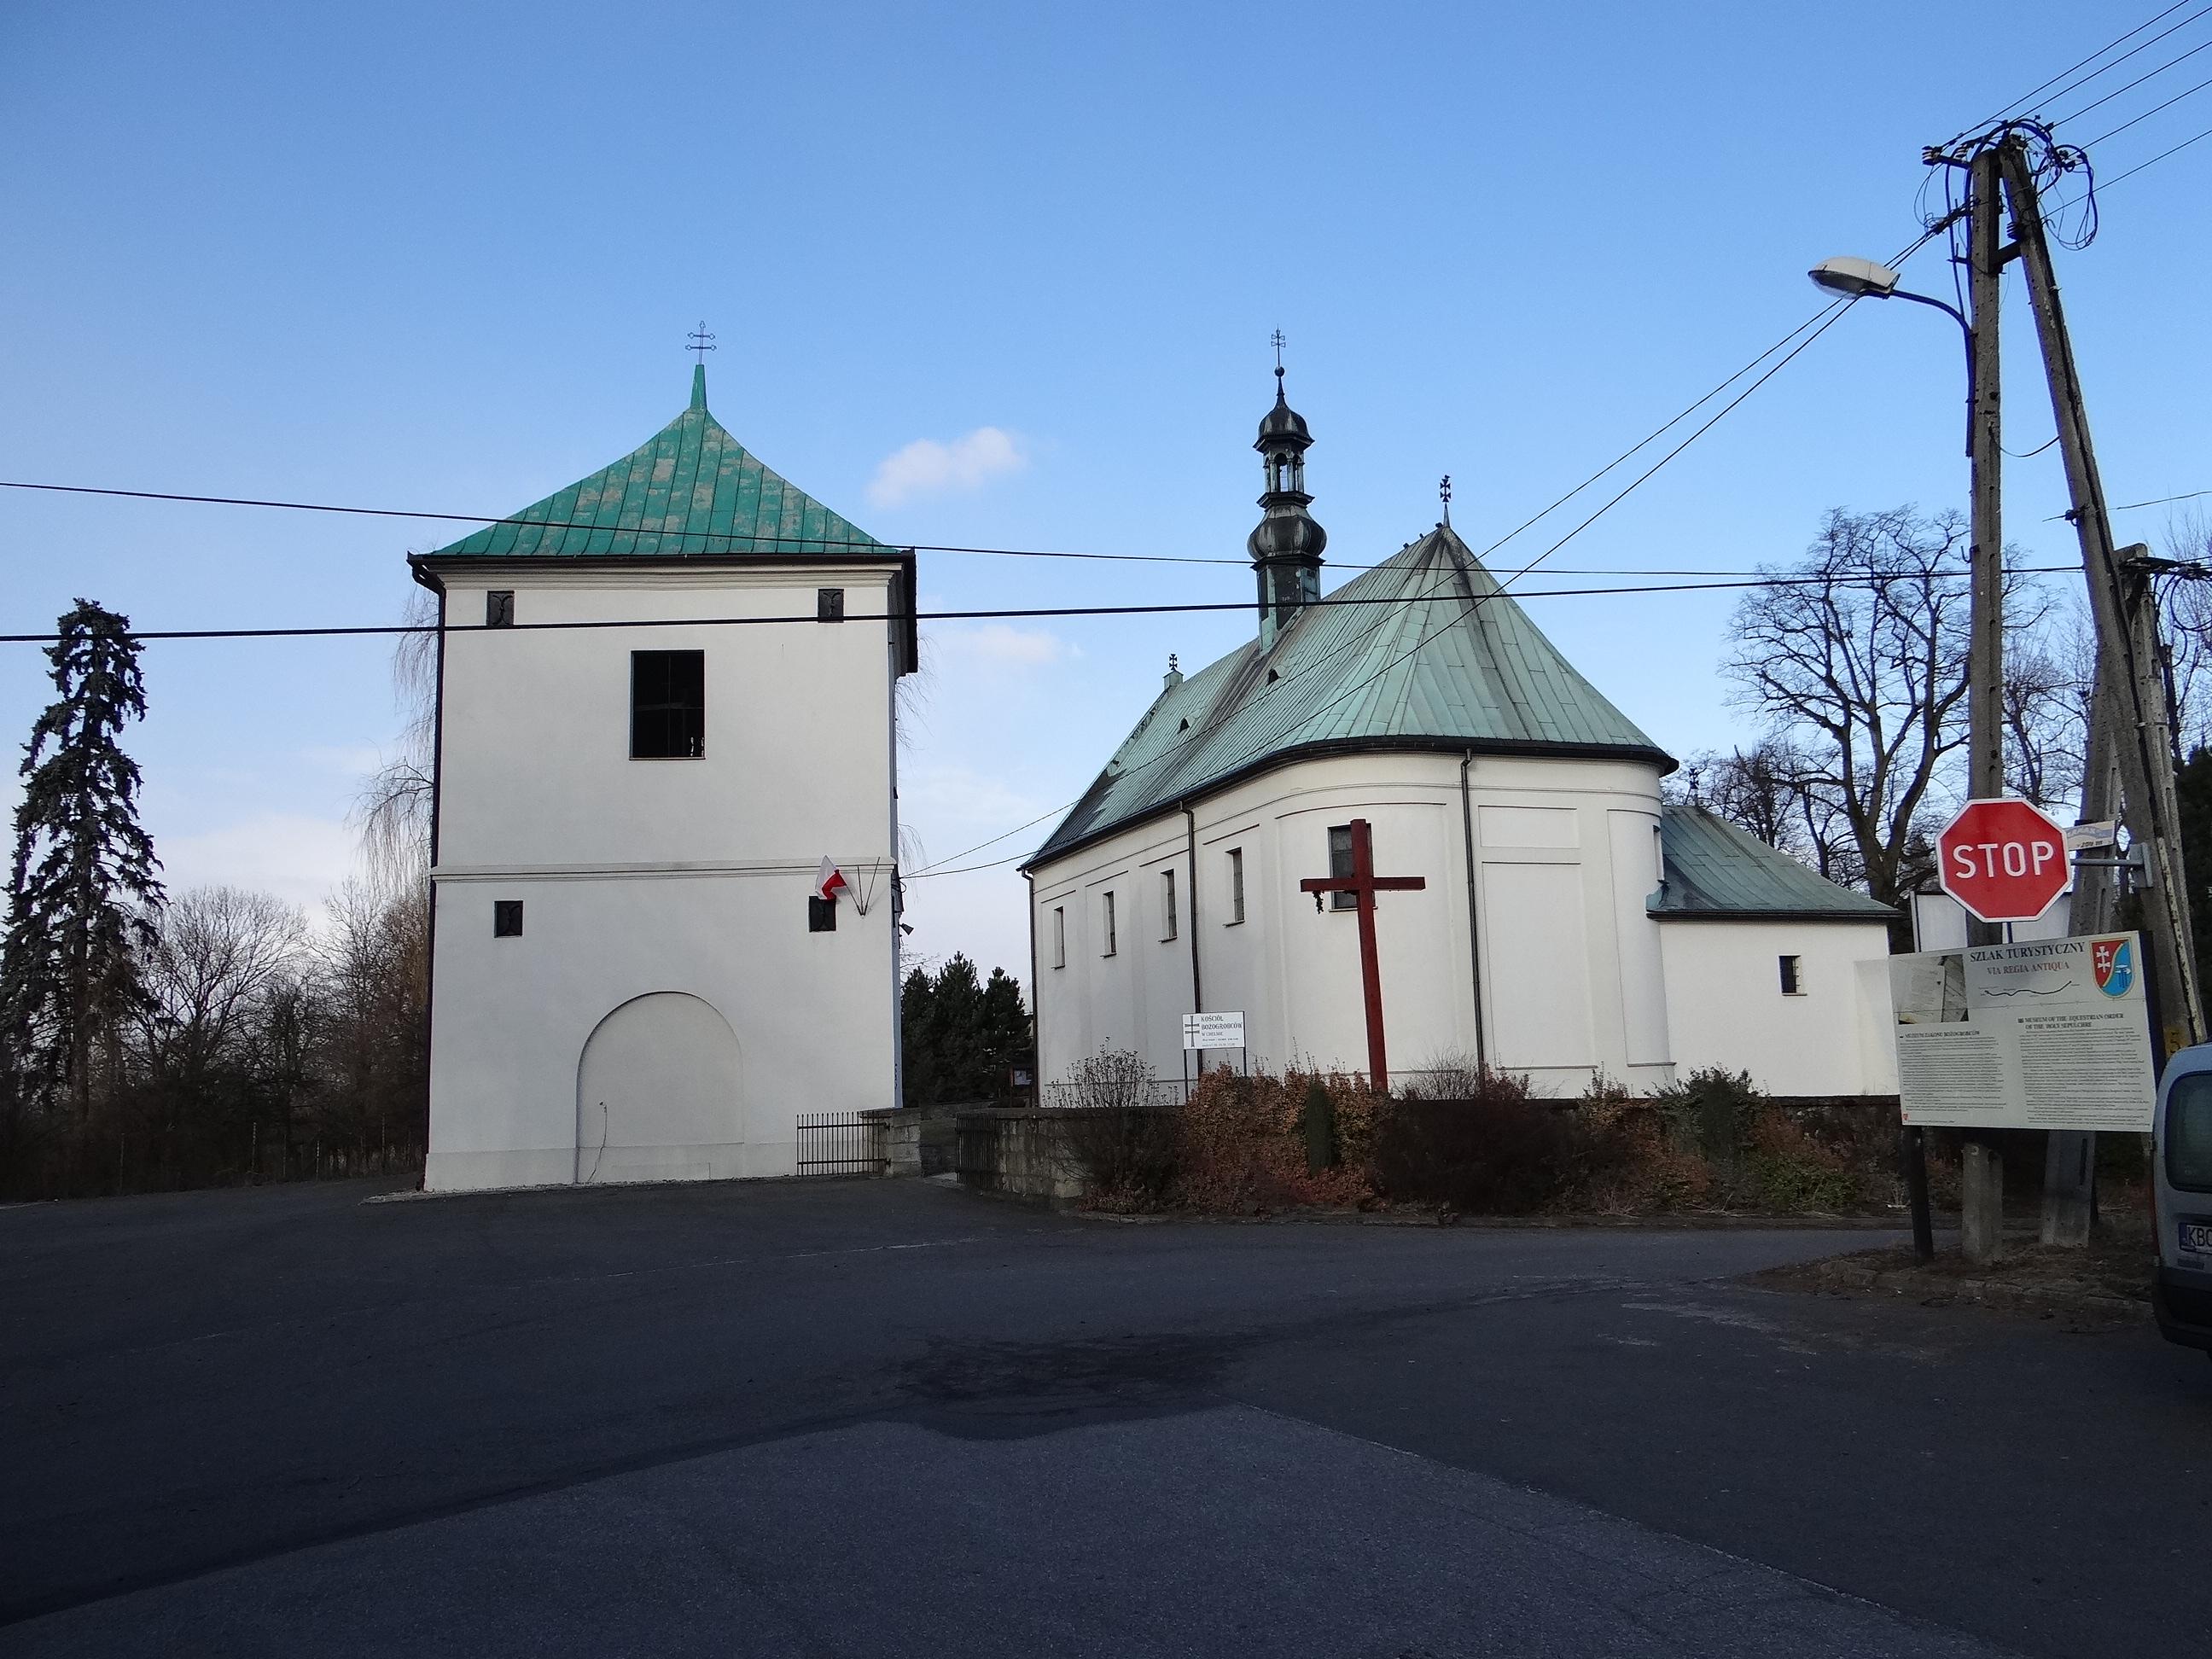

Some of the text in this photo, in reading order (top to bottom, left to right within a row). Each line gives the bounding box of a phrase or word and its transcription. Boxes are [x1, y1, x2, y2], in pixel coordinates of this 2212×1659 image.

[1953, 841, 2053, 879] STOP
[1970, 942, 2085, 962] SZLAK TURYSTYCZNY
[2004, 964, 2029, 974] REGIA
[2031, 962, 2069, 972] ANTIQUA
